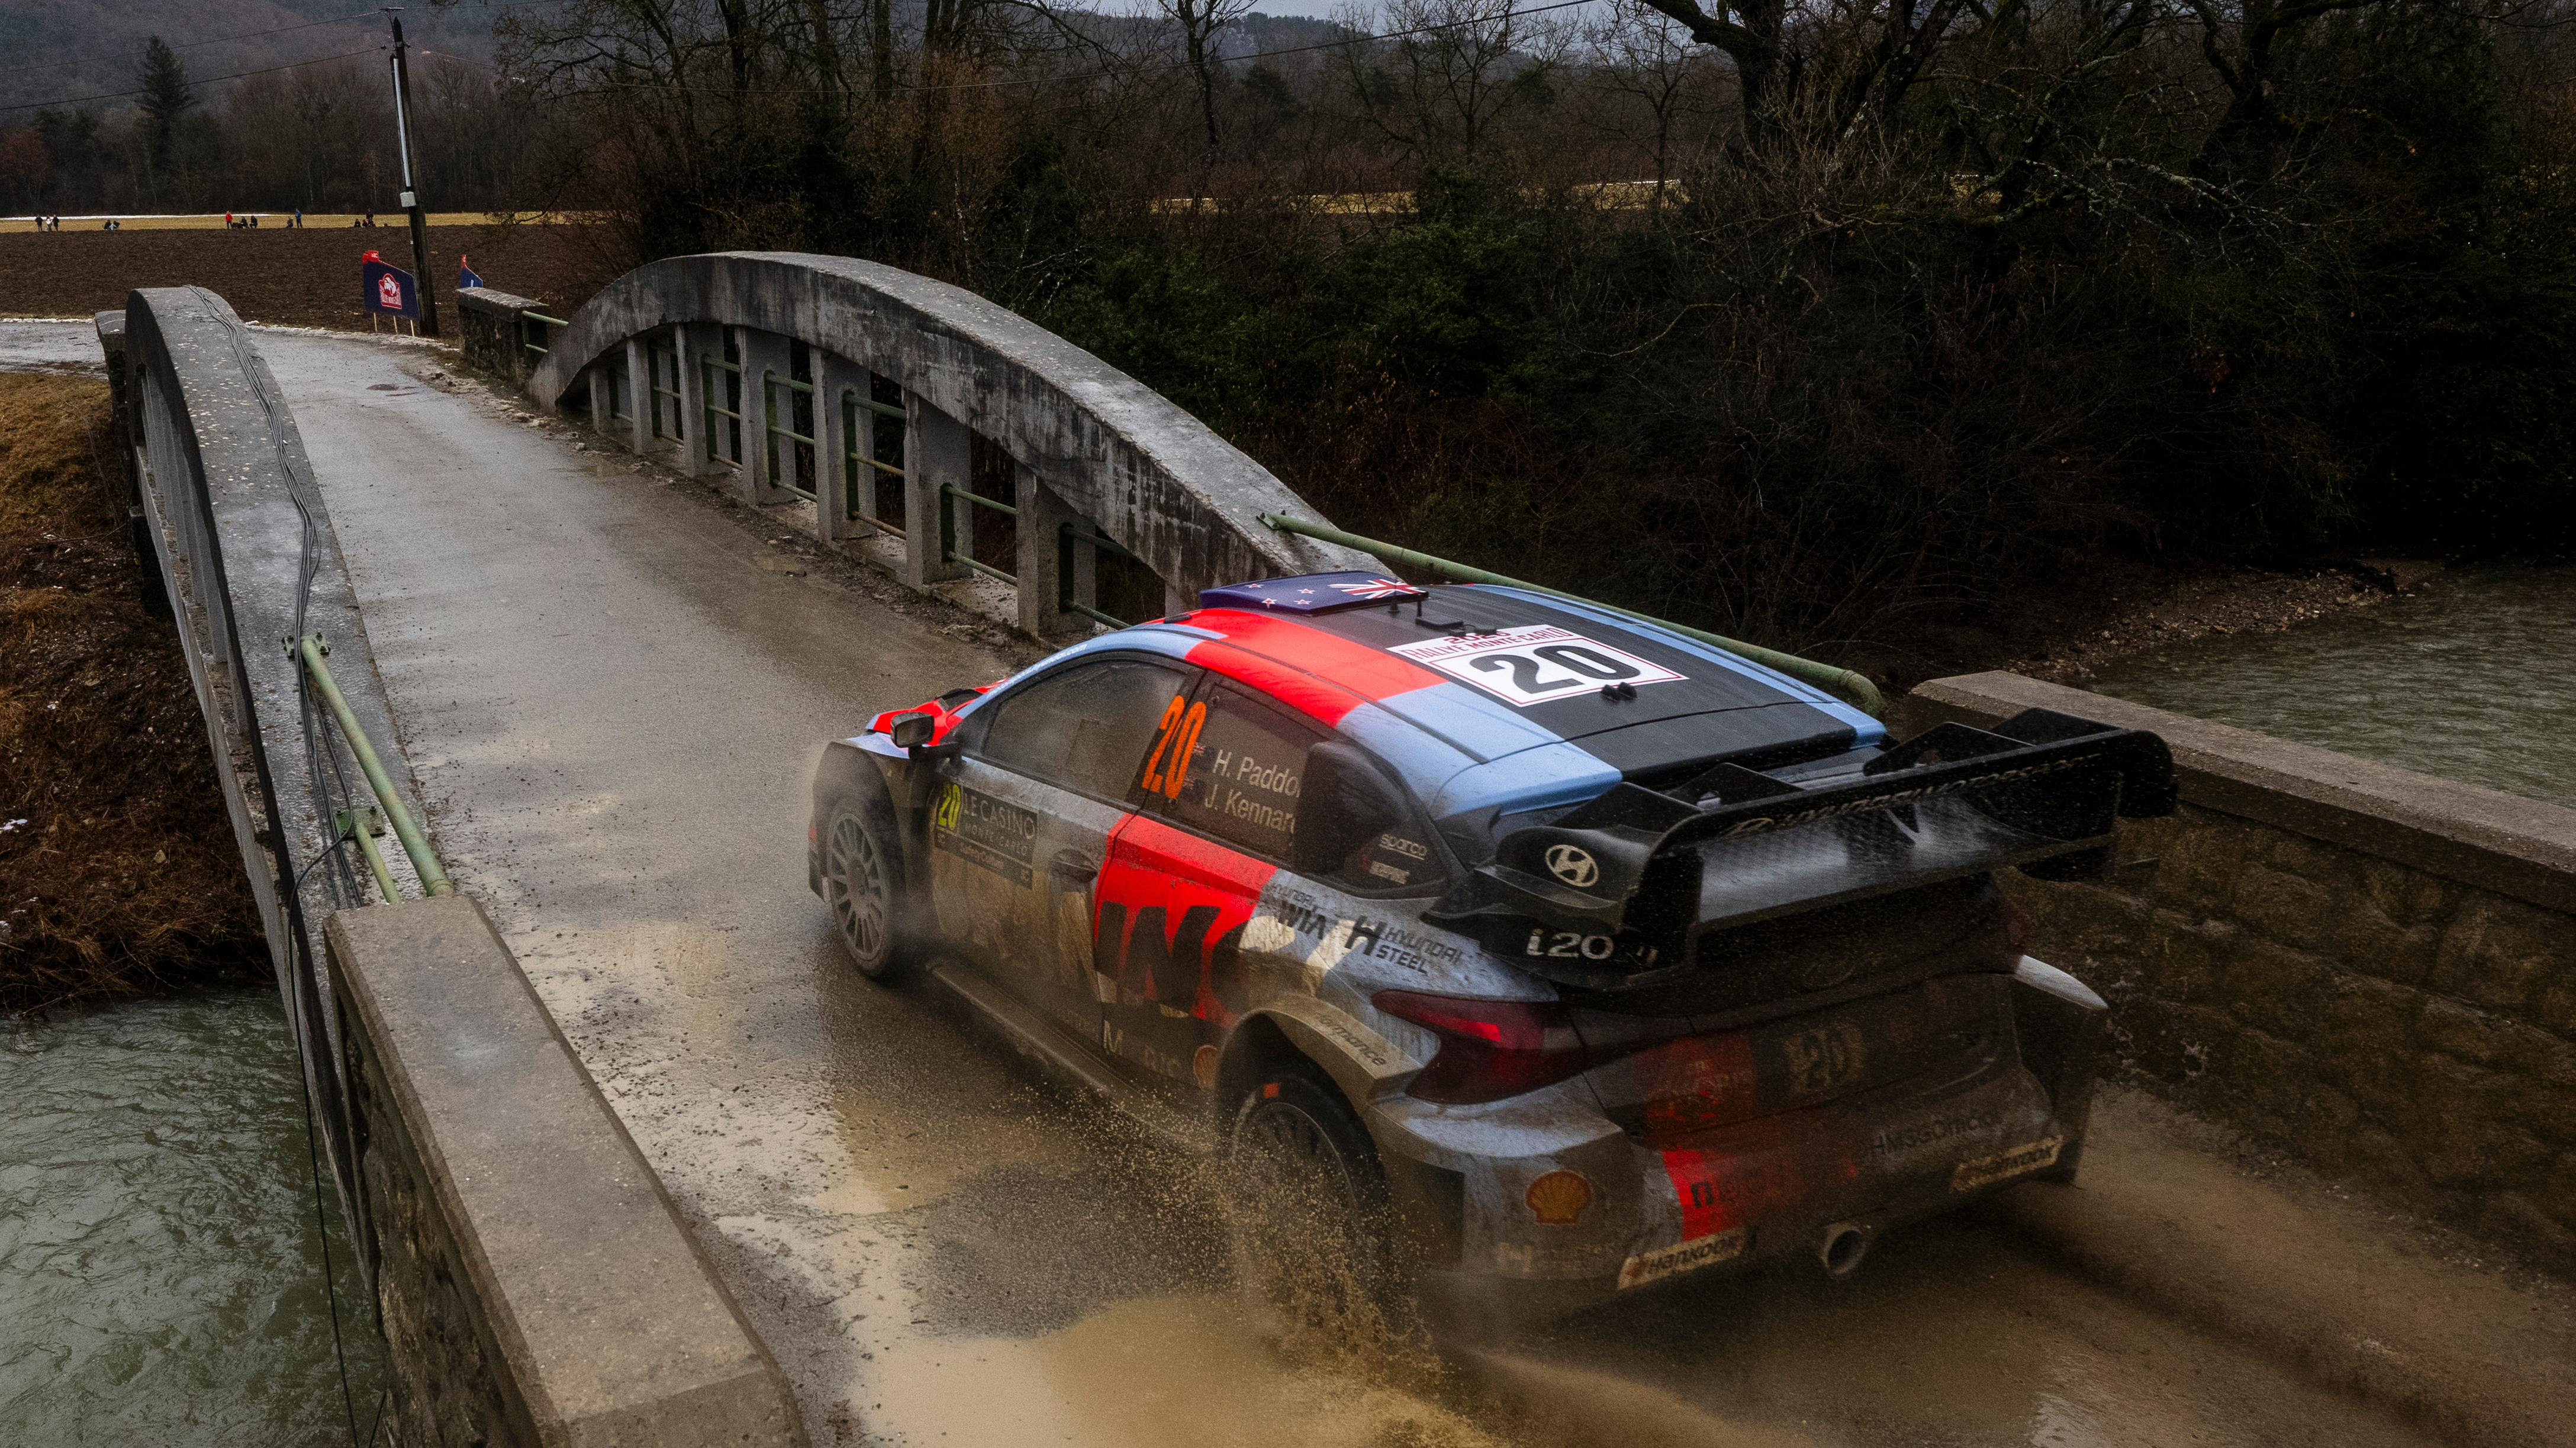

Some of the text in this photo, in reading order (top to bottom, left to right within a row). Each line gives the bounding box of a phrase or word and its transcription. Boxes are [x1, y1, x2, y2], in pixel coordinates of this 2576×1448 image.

[1403, 627, 1574, 660] RALLYE MONTE-CARLO
[1469, 646, 1641, 694] 20
[1142, 695, 1206, 799] 20
[1212, 749, 1300, 798] H. Paddo
[938, 783, 961, 831] 20
[1204, 783, 1218, 811] J.
[964, 792, 1035, 840] LE CASINO
[965, 823, 995, 843] MONTE
[999, 836, 1028, 856] CARLO
[1380, 833, 1428, 857] sparco
[1376, 944, 1428, 975] STEEL
[1380, 925, 1464, 964] HYUNDAI
[1526, 928, 1615, 960] i20
